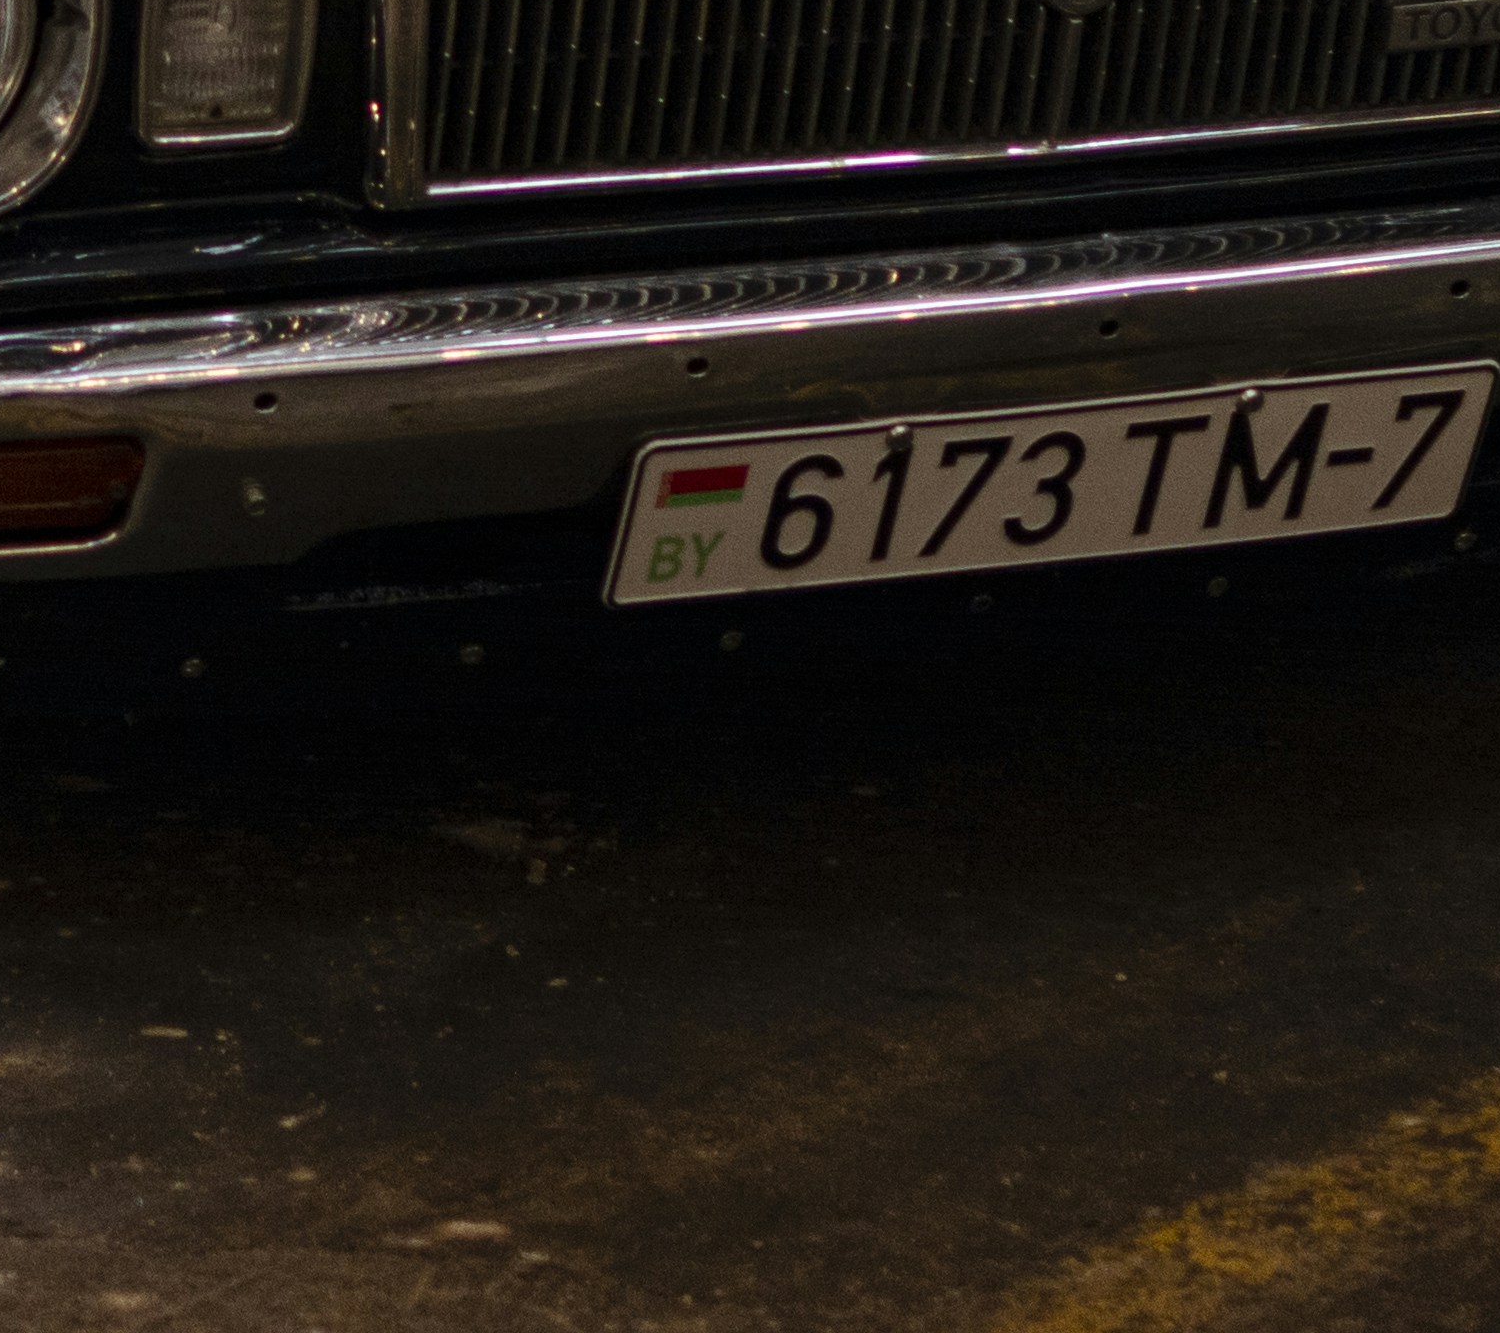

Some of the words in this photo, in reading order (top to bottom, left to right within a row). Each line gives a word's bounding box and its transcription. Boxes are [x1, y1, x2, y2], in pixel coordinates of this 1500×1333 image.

[759, 429, 1087, 571] 6173
[1125, 389, 1466, 536] TM-7
[647, 531, 726, 584] BY
